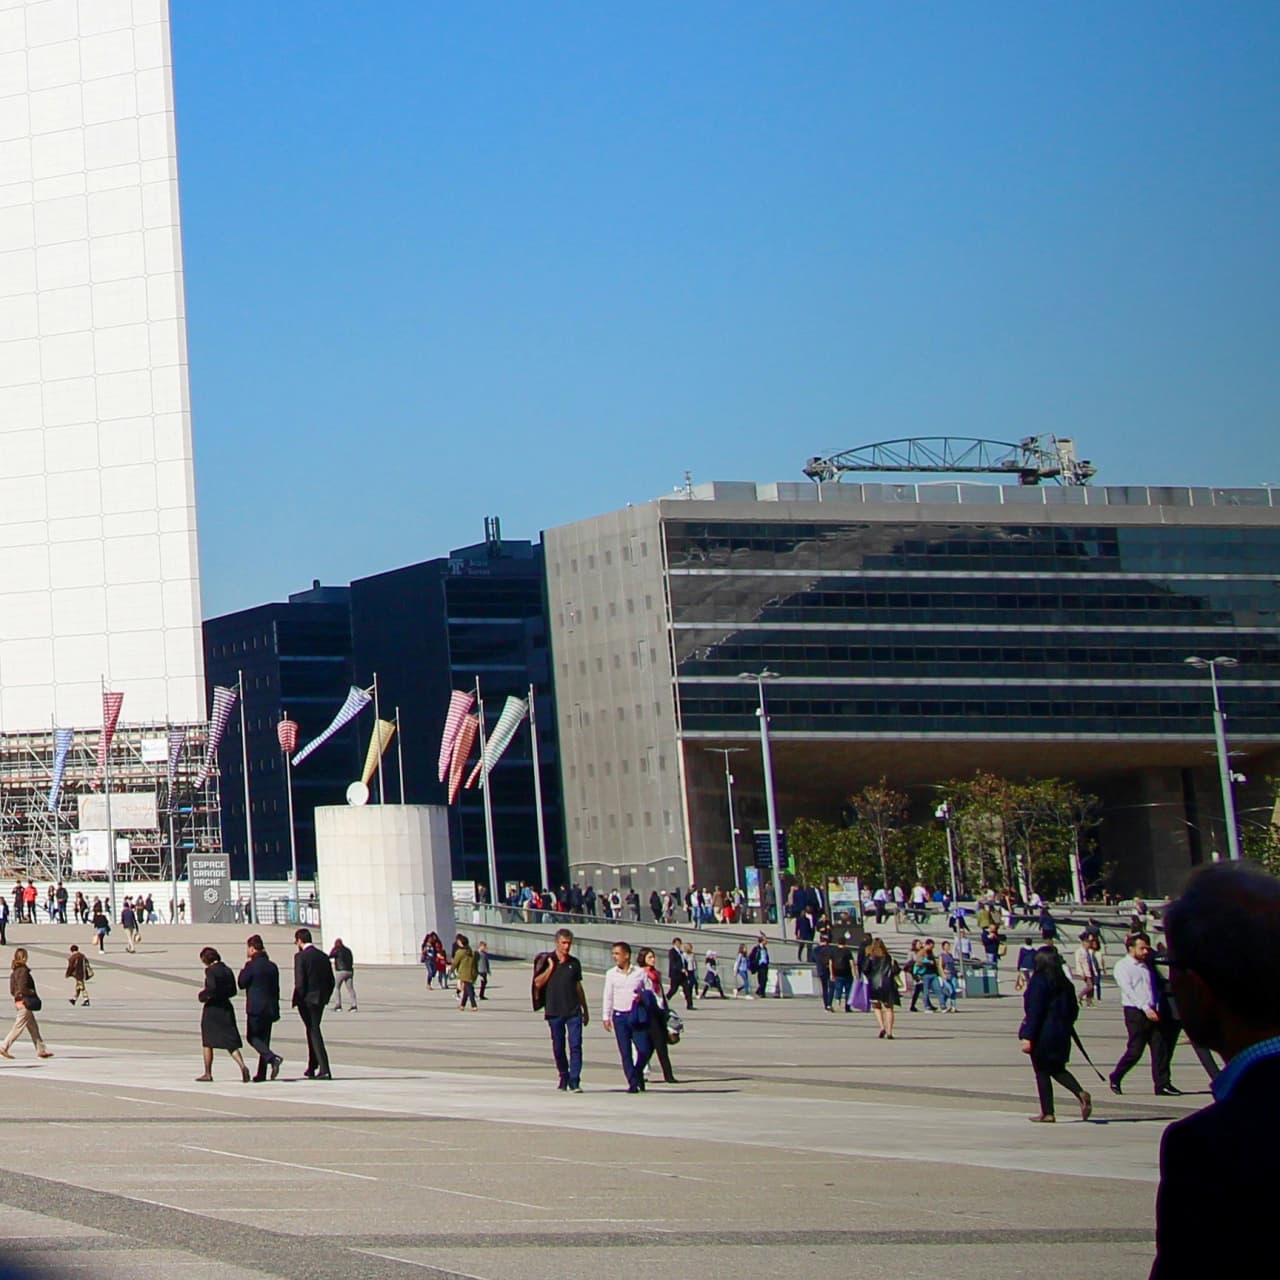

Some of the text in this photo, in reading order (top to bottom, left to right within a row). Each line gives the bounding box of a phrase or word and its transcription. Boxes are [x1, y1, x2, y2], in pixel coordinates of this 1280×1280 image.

[192, 860, 225, 869] ESPACE
[193, 869, 226, 878] GRANDE
[193, 879, 221, 887] ARCHE
